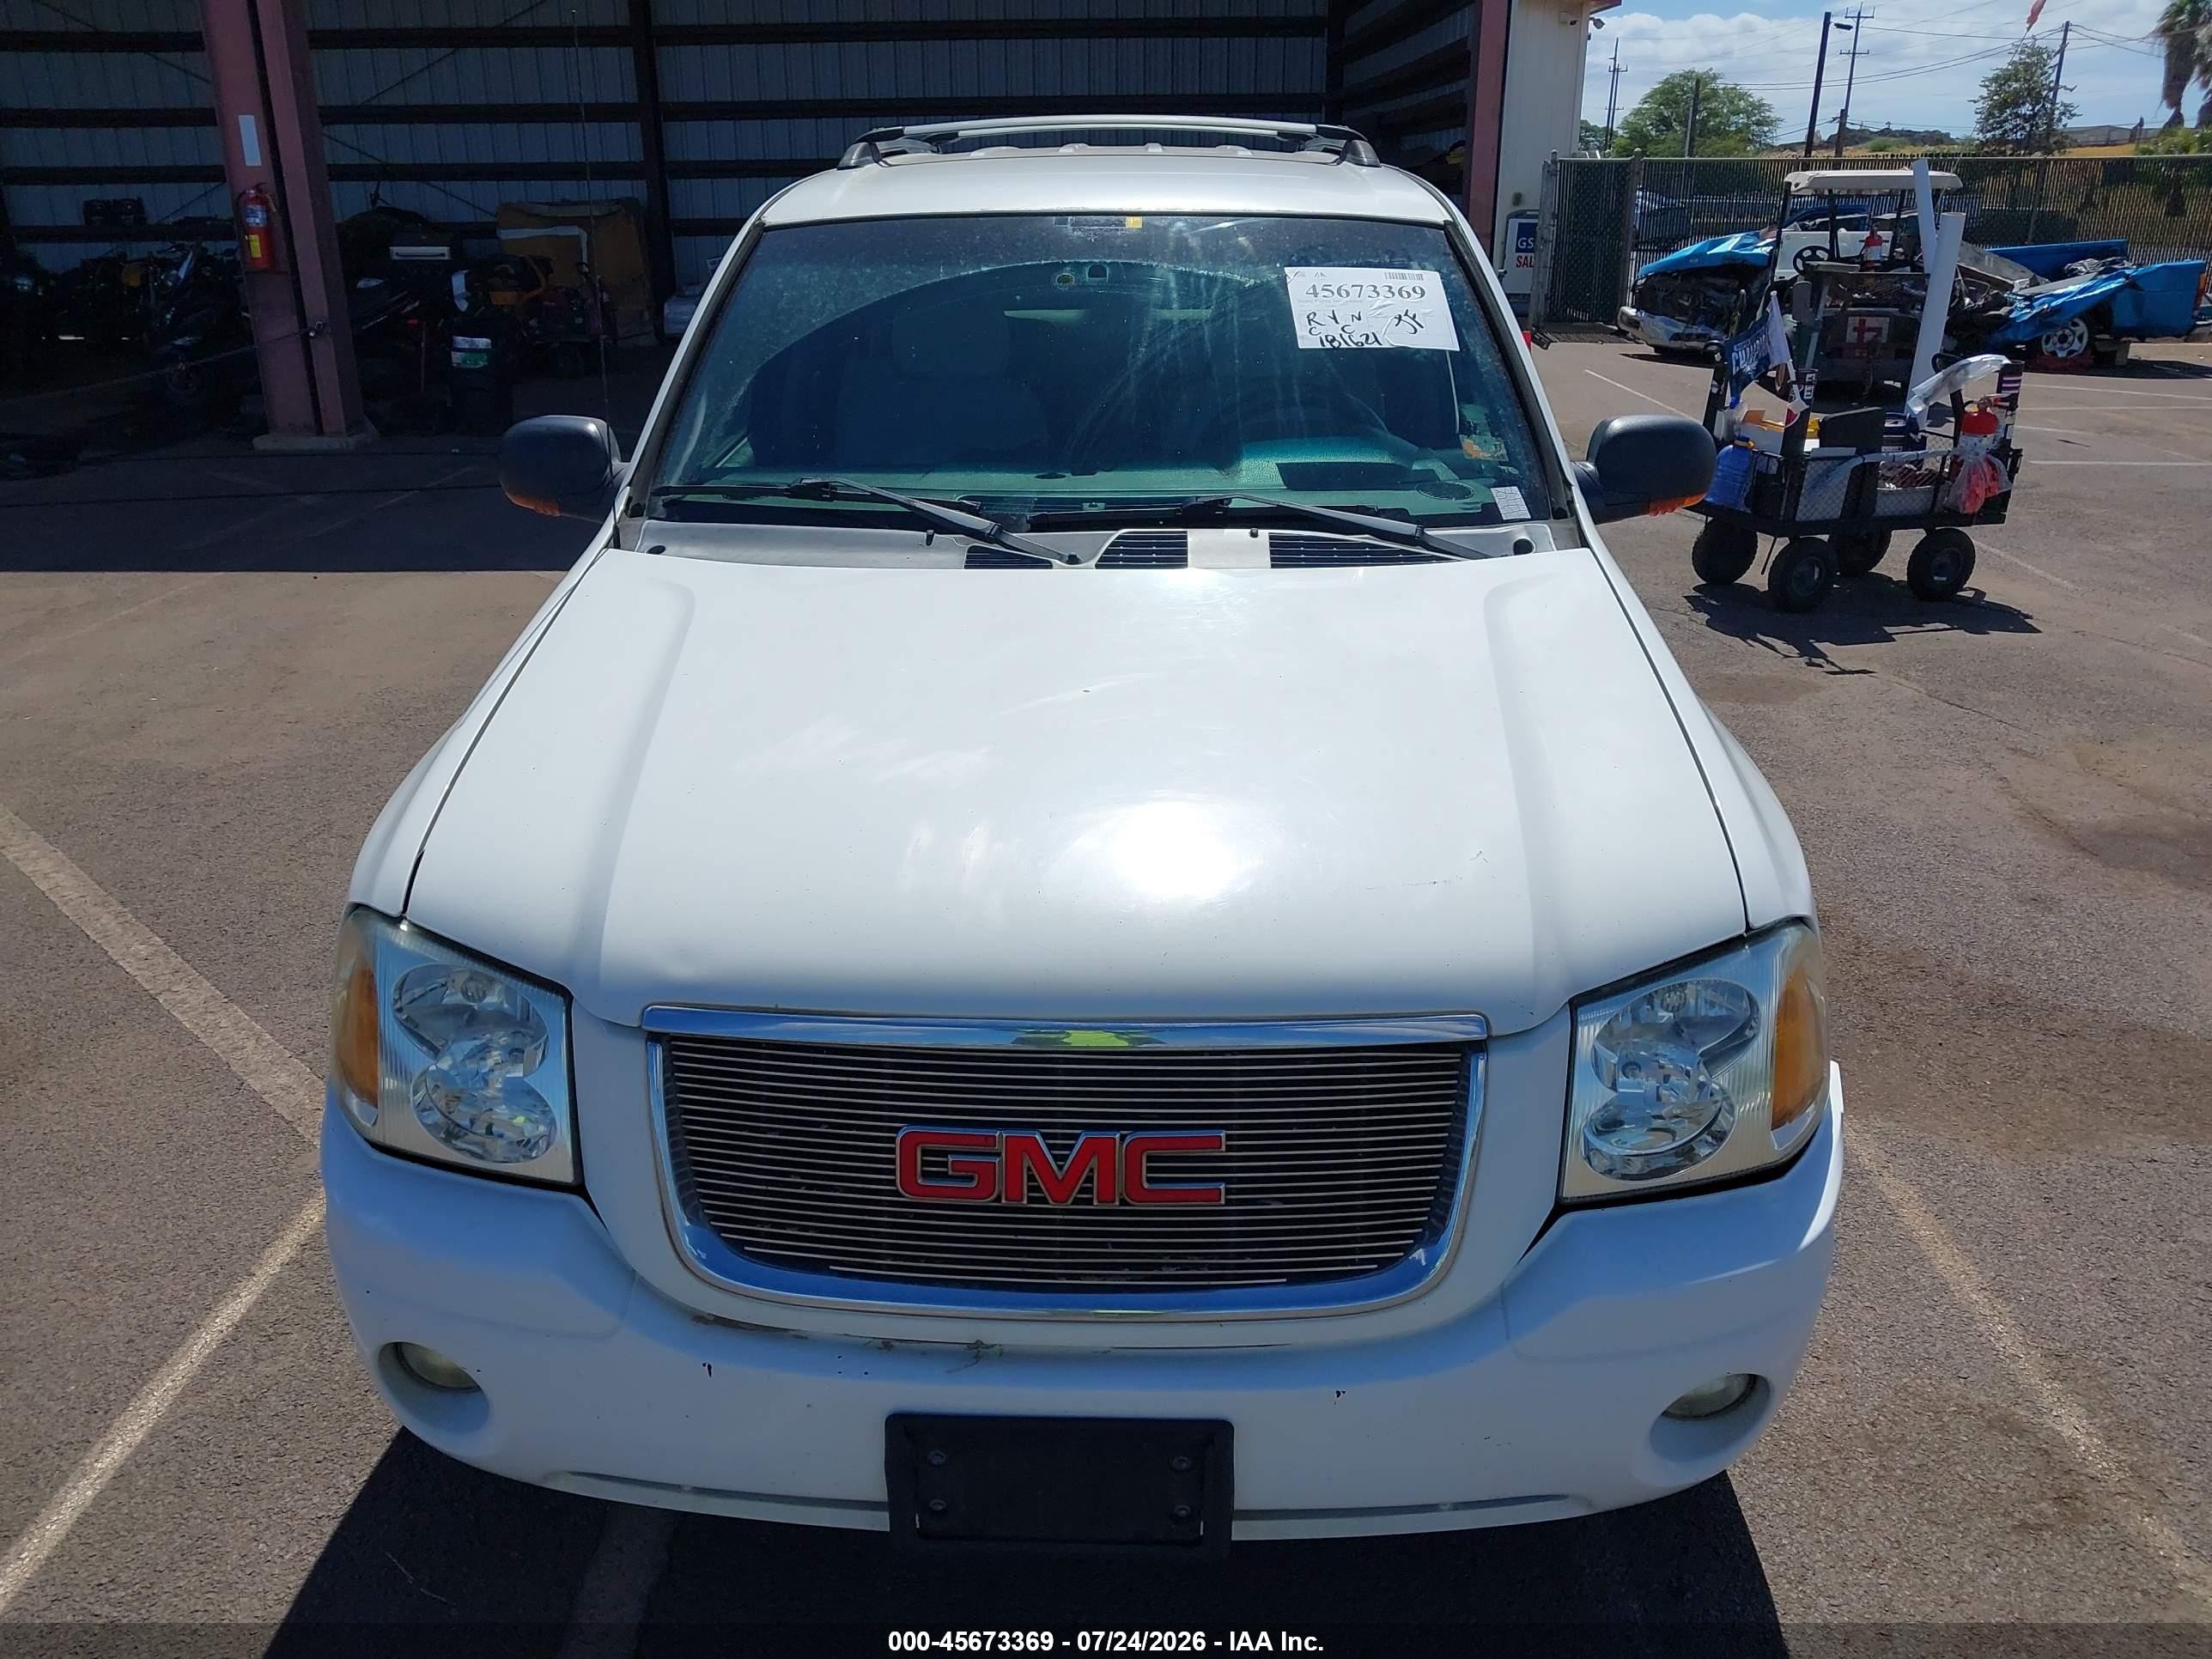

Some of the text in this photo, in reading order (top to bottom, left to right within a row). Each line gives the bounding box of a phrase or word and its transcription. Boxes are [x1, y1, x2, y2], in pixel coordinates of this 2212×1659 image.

[1517, 237, 1534, 249] GS
[1516, 255, 1534, 268] SAL
[1305, 284, 1426, 300] 45673369
[896, 1124, 1227, 1206] GMC
